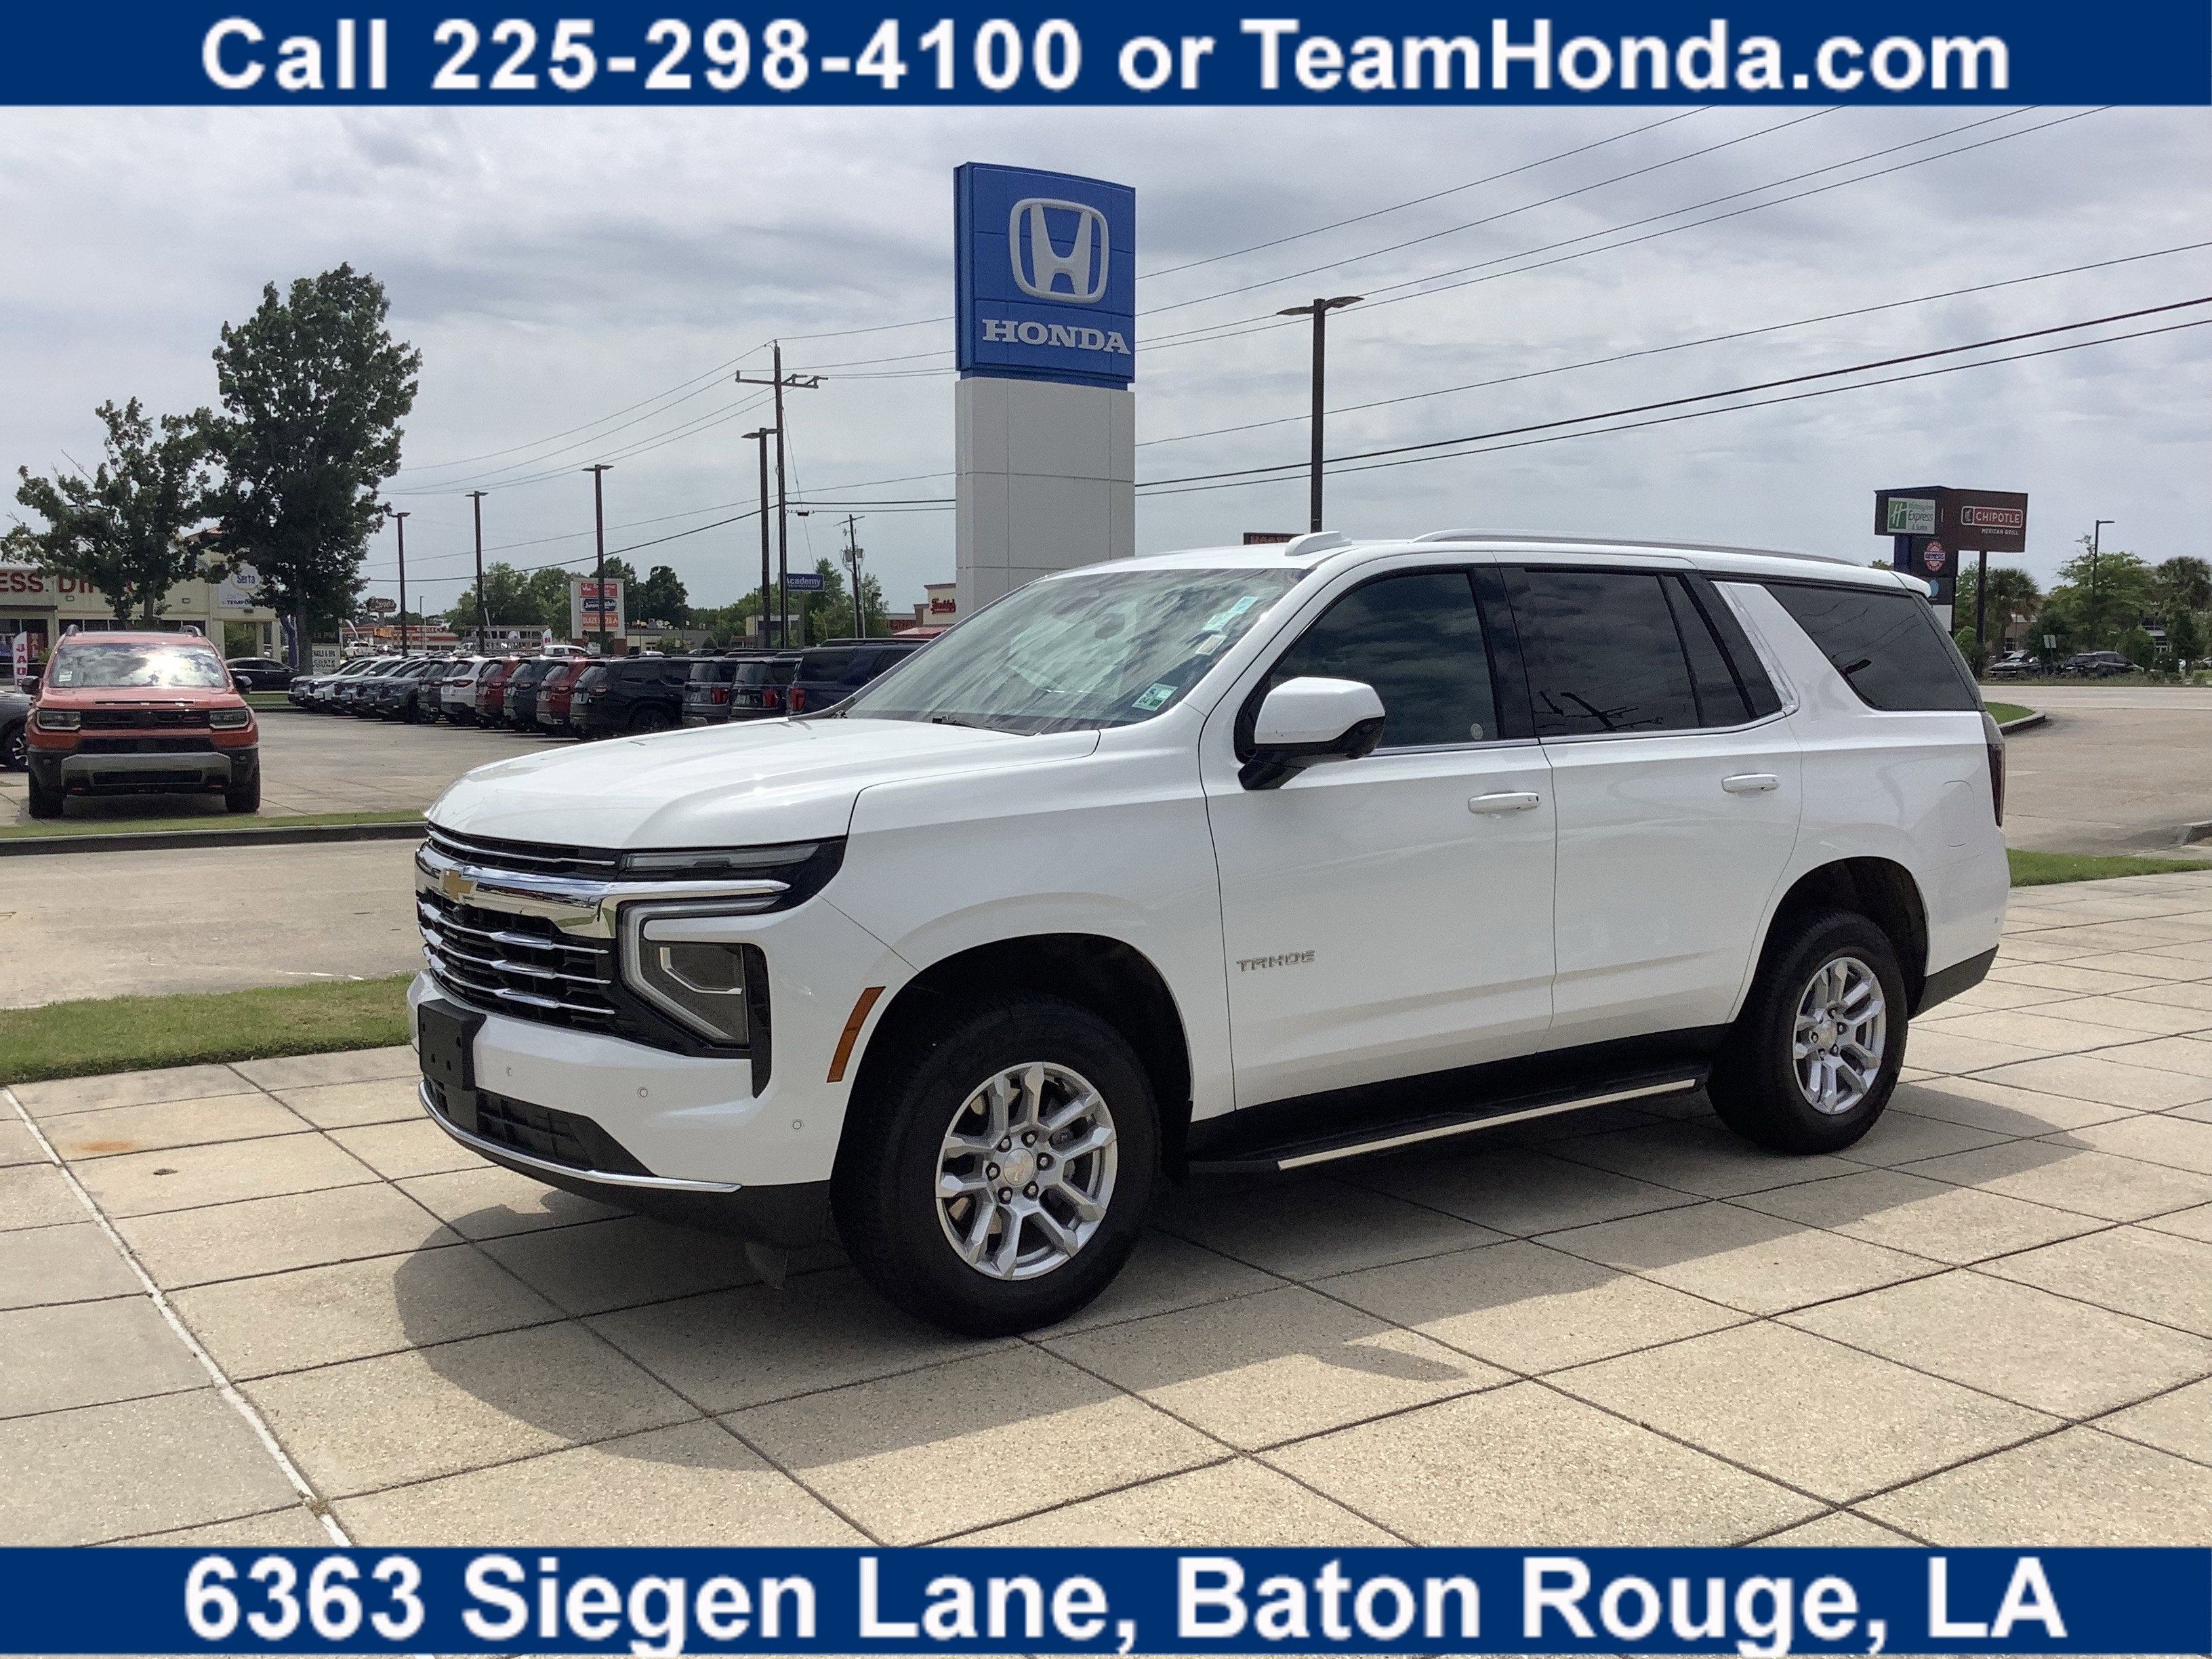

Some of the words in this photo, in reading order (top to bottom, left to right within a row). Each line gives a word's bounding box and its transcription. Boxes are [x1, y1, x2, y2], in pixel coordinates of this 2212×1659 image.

[982, 319, 1131, 354] HONDA
[1908, 510, 1933, 523] Express
[1975, 512, 2020, 523] CHIPOTLE
[237, 574, 255, 583] Serta
[1236, 950, 1315, 972] TAHOE
